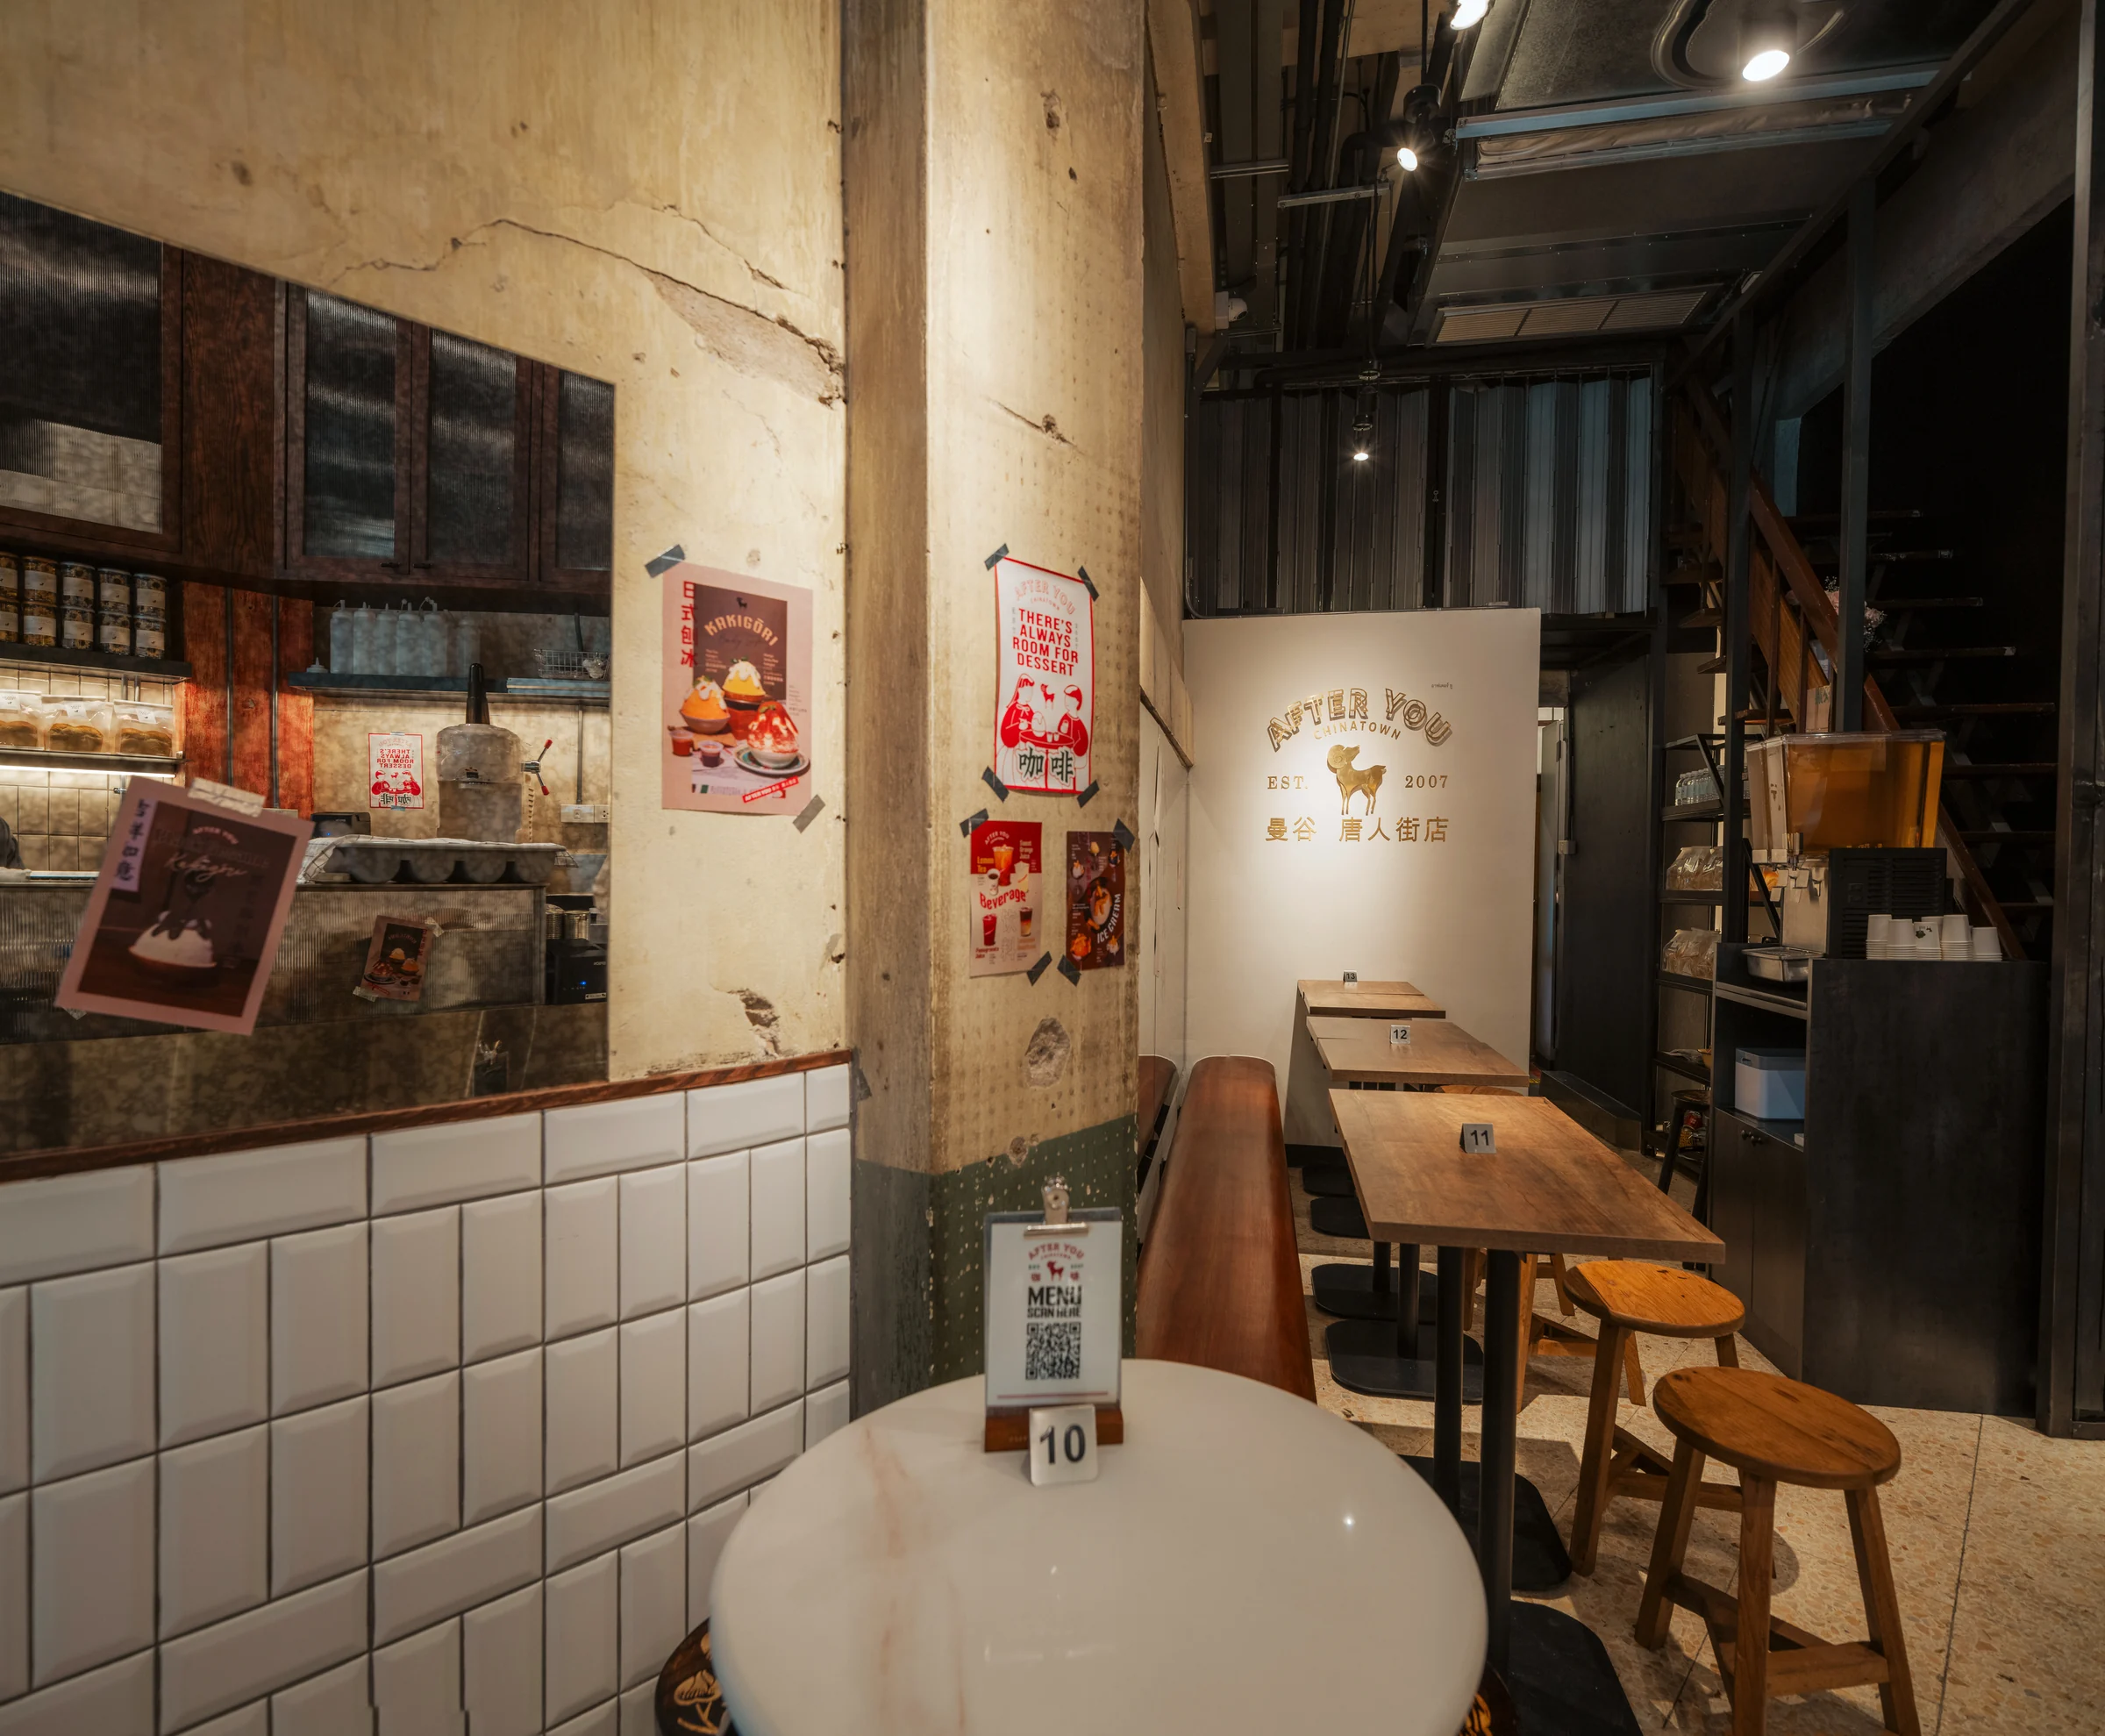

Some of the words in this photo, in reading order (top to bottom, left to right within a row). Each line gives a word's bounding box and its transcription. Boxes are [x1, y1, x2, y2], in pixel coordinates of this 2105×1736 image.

[1015, 579, 1050, 601] AFTER
[1052, 584, 1076, 615] YOU
[1018, 608, 1073, 634] THERE'S
[1020, 624, 1071, 647] ALWAYS
[1012, 636, 1050, 657] ROOM
[1055, 647, 1079, 663] FOR
[1017, 652, 1074, 676] DESSERT
[1267, 688, 1369, 752] AFTER
[1385, 688, 1452, 747] YOU
[1313, 720, 1402, 740] CHINATOWN
[1018, 747, 1075, 784] 咖啡
[1267, 775, 1309, 789] EST.
[1405, 775, 1448, 789] 2007
[1266, 817, 1317, 842] 曼谷
[1338, 816, 1450, 843] 唐人街店
[980, 889, 1026, 910] Beverage
[1096, 928, 1110, 944] ICE
[1107, 893, 1122, 932] CREAM
[1393, 1029, 1408, 1039] 12
[1470, 1129, 1489, 1147] 11
[1028, 1243, 1060, 1261] AFTER
[1064, 1242, 1084, 1260] YOU
[1028, 1285, 1082, 1305] MENU
[1027, 1306, 1054, 1318] SCAN
[1056, 1306, 1081, 1318] HERE
[1039, 1424, 1086, 1464] 10
